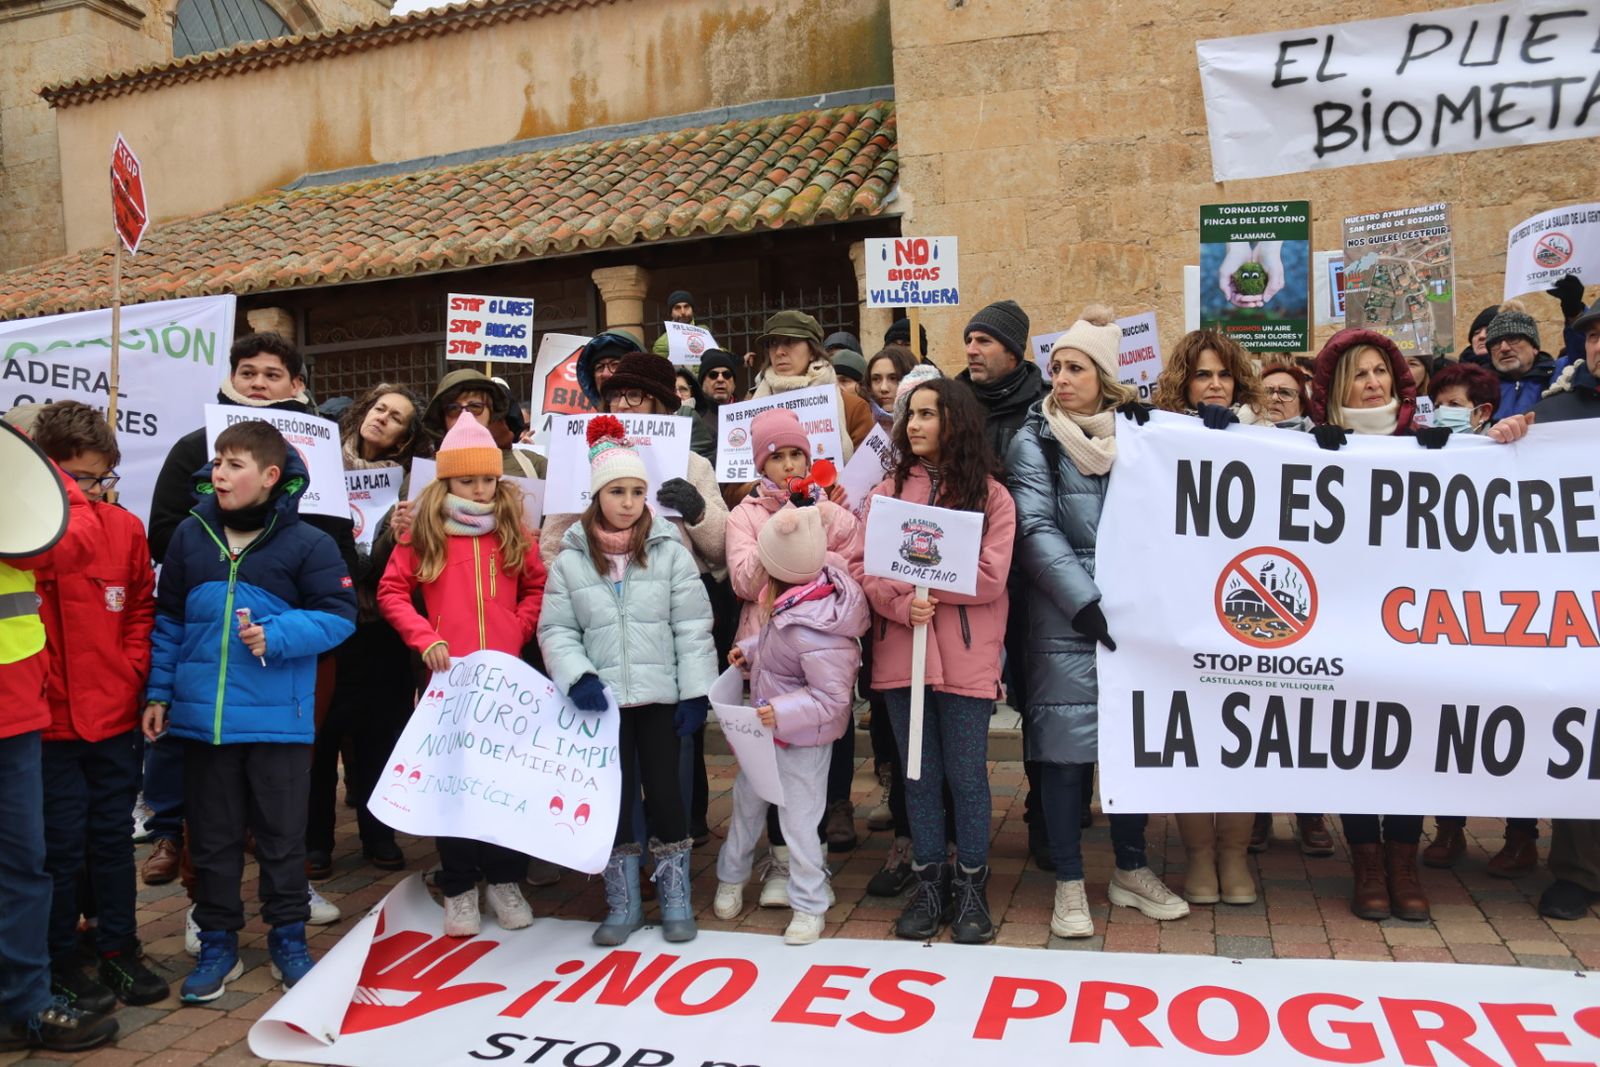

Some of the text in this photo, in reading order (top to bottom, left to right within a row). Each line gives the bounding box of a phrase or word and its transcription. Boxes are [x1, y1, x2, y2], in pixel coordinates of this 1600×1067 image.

[1272, 11, 1600, 88] EL PUE
[1219, 205, 1280, 215] TORNADIZOS
[1345, 203, 1446, 224] NUESTRO AYUNTAMIENTO
[1204, 218, 1238, 226] FINCAS
[1260, 215, 1306, 224] ENTORNO
[1349, 225, 1364, 233] SAN
[1366, 222, 1392, 231] PEDRO
[1407, 214, 1445, 225] ROZADOS
[1545, 217, 1551, 229] LA
[1571, 212, 1578, 224] DE
[1580, 212, 1586, 223] LA
[1230, 232, 1276, 240] SALAMANCA
[1348, 238, 1365, 247] NOS
[1368, 234, 1399, 244] QUIERE
[888, 267, 941, 281] BIOGAS
[1527, 267, 1582, 281] STOP BIOGAS
[901, 281, 919, 291] EN
[450, 298, 485, 312] STOP
[871, 288, 959, 304] VILLIQUERA
[449, 319, 526, 339] STOP BIOGAS
[448, 340, 528, 358] STOP MIERDA
[1040, 344, 1050, 353] NO
[726, 413, 734, 422] NO
[736, 411, 743, 420] ES
[786, 394, 829, 410] DESTRUCCIÓN
[271, 417, 330, 440] AERÓDROMO
[567, 419, 584, 436] POR
[633, 420, 645, 436] LA
[647, 420, 675, 437] PLATA
[350, 475, 361, 491] LA
[363, 473, 390, 489] PLATA
[726, 468, 747, 478] SE
[1175, 459, 1256, 540] NO
[1279, 463, 1346, 545] ES
[918, 519, 937, 528] SALUD
[891, 561, 957, 583] BIOMETANO
[1381, 586, 1600, 648] CALZA
[1193, 653, 1344, 677] STOP BIOGAS
[1199, 676, 1263, 687] CASTELLANOS
[1280, 682, 1335, 691] VILLIQUERA
[448, 661, 601, 738] QUEREMOS UN
[438, 690, 617, 768] FUTURO LIMPIO
[1132, 690, 1199, 768] LA
[1221, 692, 1412, 771] SALUD
[1435, 704, 1526, 777] NO
[771, 964, 946, 1034] ES
[468, 1032, 675, 1067] STOP
